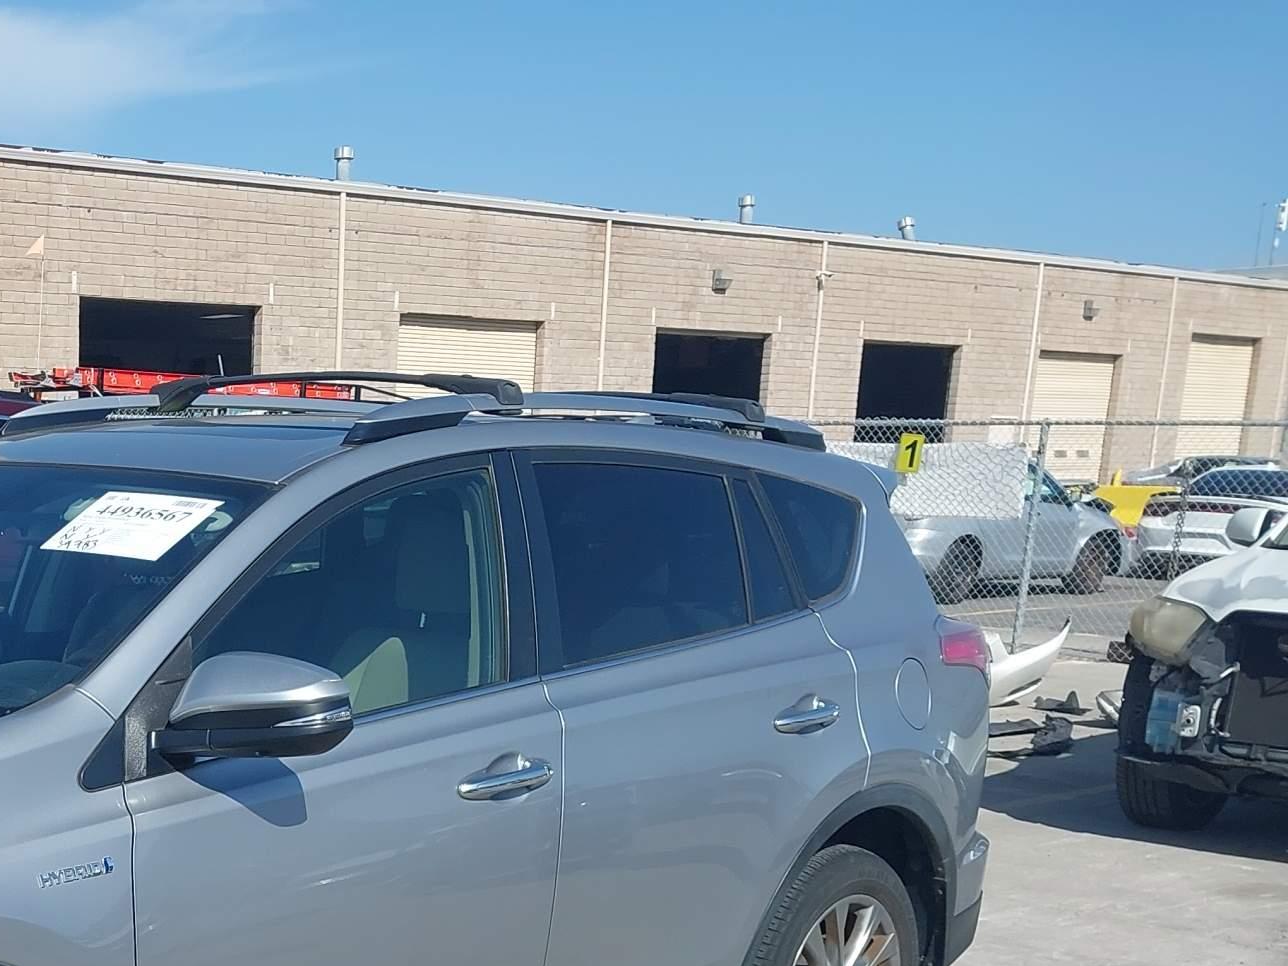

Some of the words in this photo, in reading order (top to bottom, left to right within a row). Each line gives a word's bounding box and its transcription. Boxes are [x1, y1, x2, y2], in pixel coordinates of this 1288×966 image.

[905, 439, 918, 467] 1
[96, 504, 193, 524] 44936567
[38, 861, 103, 889] HYBRID
